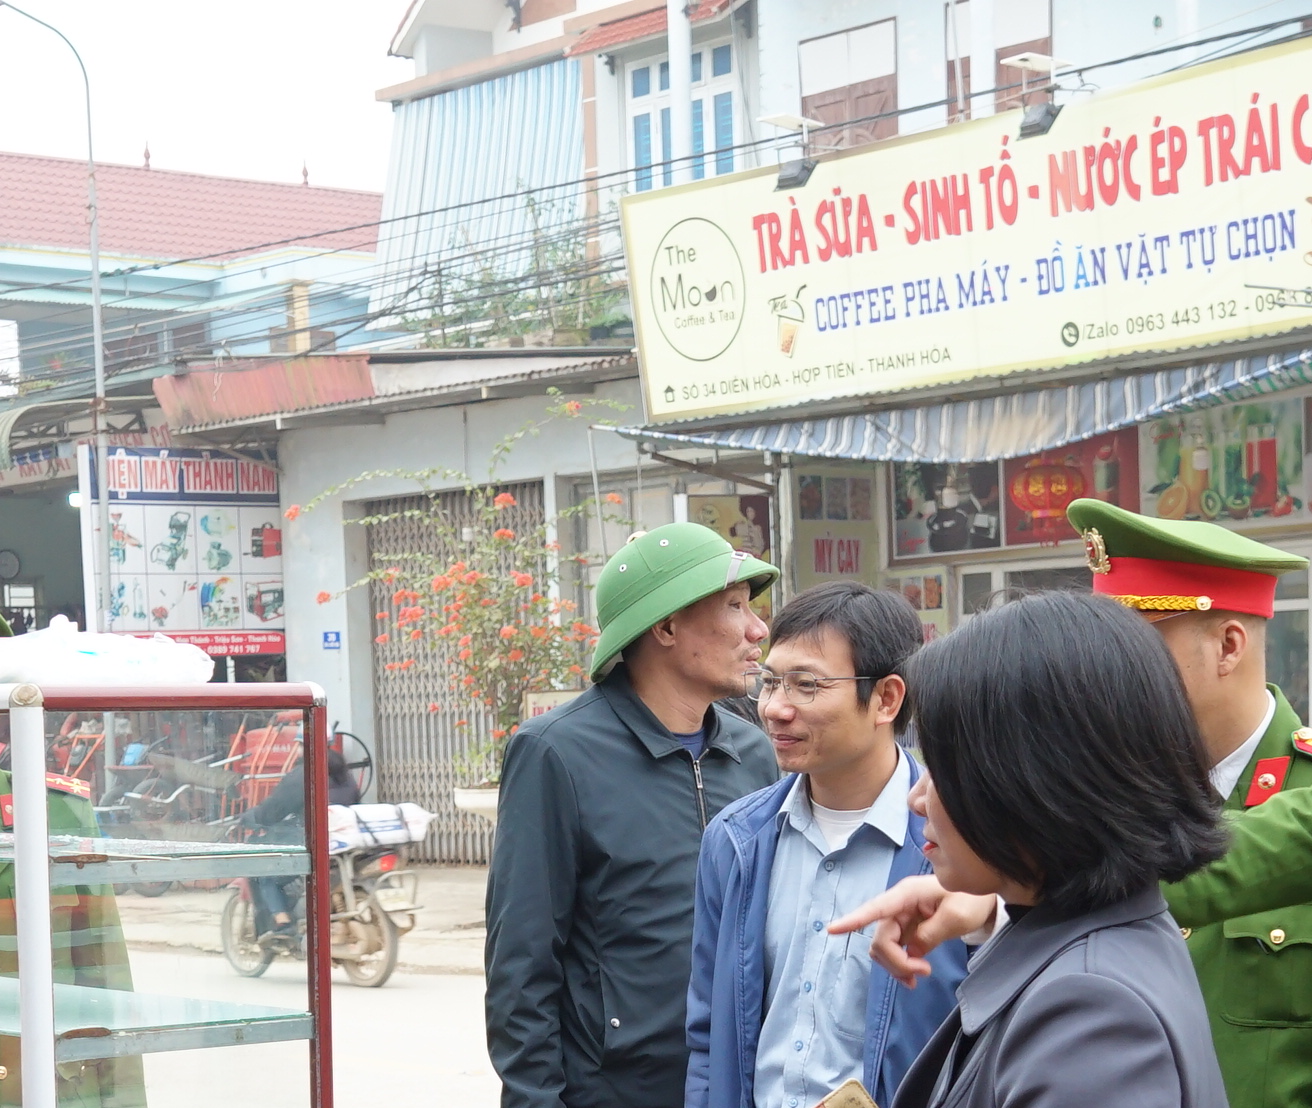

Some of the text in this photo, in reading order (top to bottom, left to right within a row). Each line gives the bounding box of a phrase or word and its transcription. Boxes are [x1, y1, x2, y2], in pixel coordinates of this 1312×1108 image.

[752, 196, 809, 273] TRÀ
[814, 186, 878, 262] SỮA
[903, 173, 973, 245] SINH
[979, 134, 1019, 231] TỐ
[1048, 126, 1141, 217] NƯỚC
[1150, 116, 1187, 196] ÉP
[1198, 92, 1281, 187] TRÁI
[664, 245, 697, 266] The
[814, 209, 1296, 332] COFFEE PHA MÁY ĐỒ ĂN VẶT TỰ CHỌN
[674, 314, 705, 329] Coffee
[718, 309, 736, 322] Tea
[1125, 312, 1166, 335] 0963
[1171, 307, 1201, 327] 443
[1209, 300, 1237, 321] 132
[703, 382, 716, 398] 34
[867, 352, 916, 373] THANH
[107, 450, 139, 498] IỆN
[143, 451, 179, 491] MÁY
[239, 460, 276, 492] NAM
[838, 538, 860, 574] CAY
